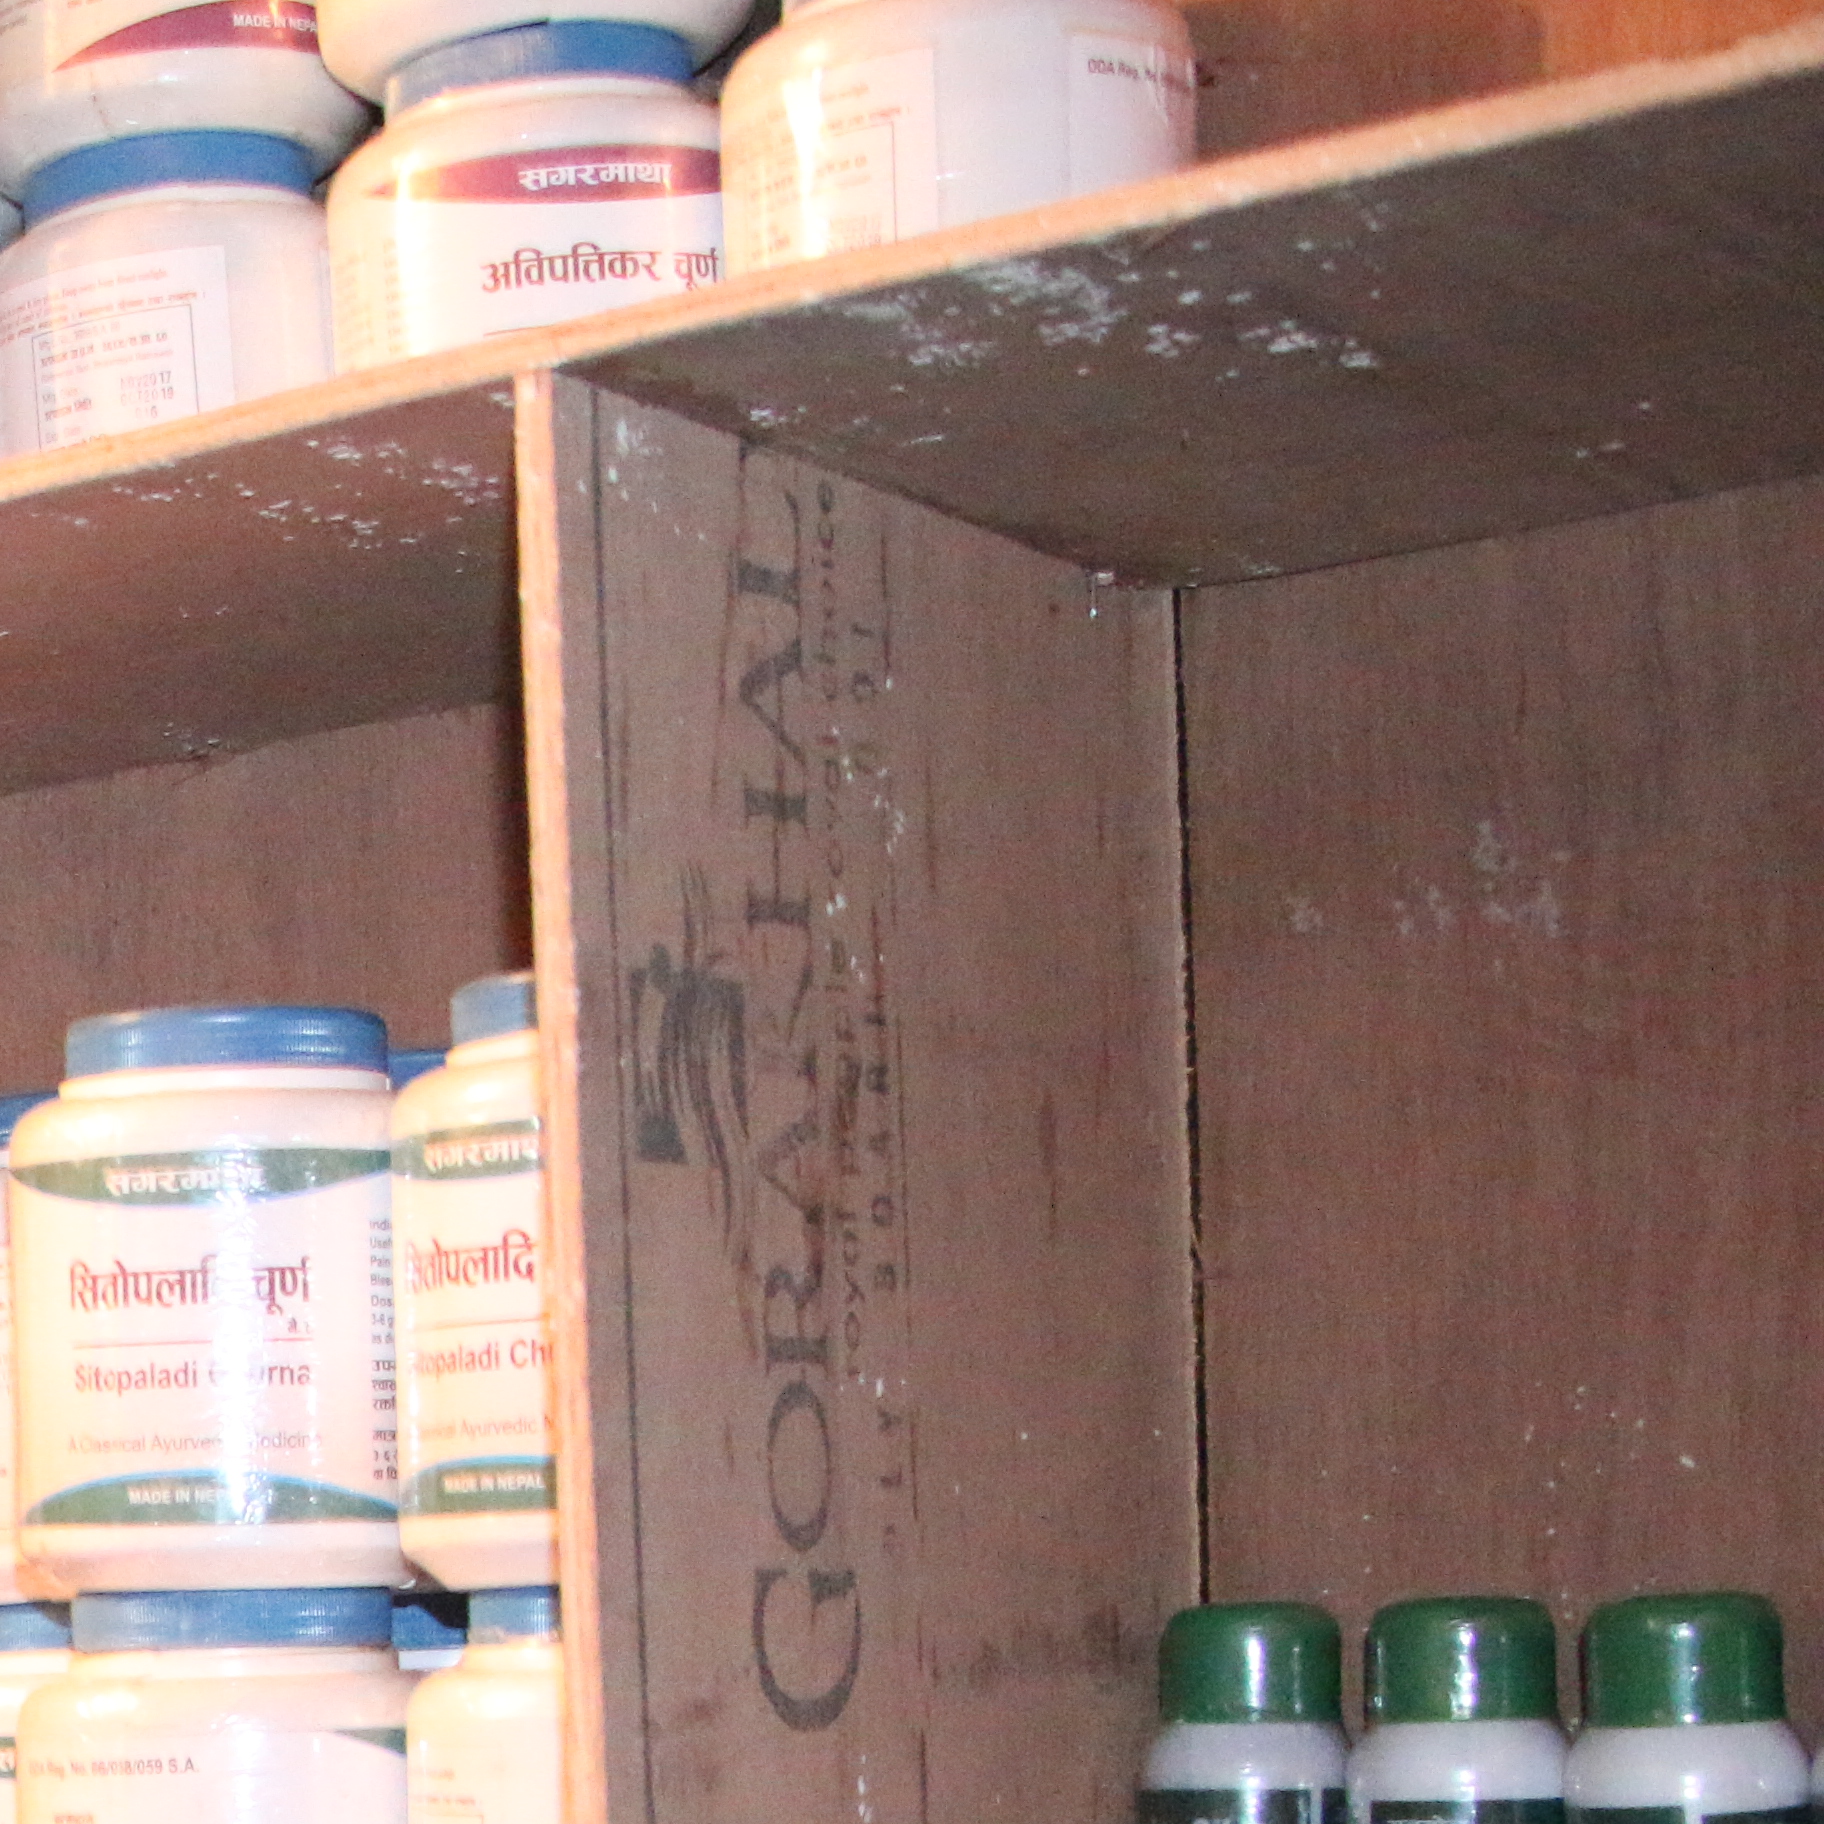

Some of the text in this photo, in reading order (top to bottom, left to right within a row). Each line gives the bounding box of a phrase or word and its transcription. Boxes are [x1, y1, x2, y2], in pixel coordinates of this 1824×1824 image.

[233, 14, 286, 28] MADE IN
[518, 163, 672, 191] सगरमाथा
[673, 247, 719, 291] चूर्ण
[813, 480, 842, 703] choice
[735, 440, 865, 1734] GORAKHAL
[105, 1167, 263, 1196] सगरमाा
[71, 1254, 311, 1316] सितोपलाि चूर्ण
[75, 1361, 197, 1396] Sitopaladi
[128, 1486, 190, 1505] MADE IN
[498, 1474, 544, 1492] NEPAL
[168, 1757, 200, 1774] S.A.
